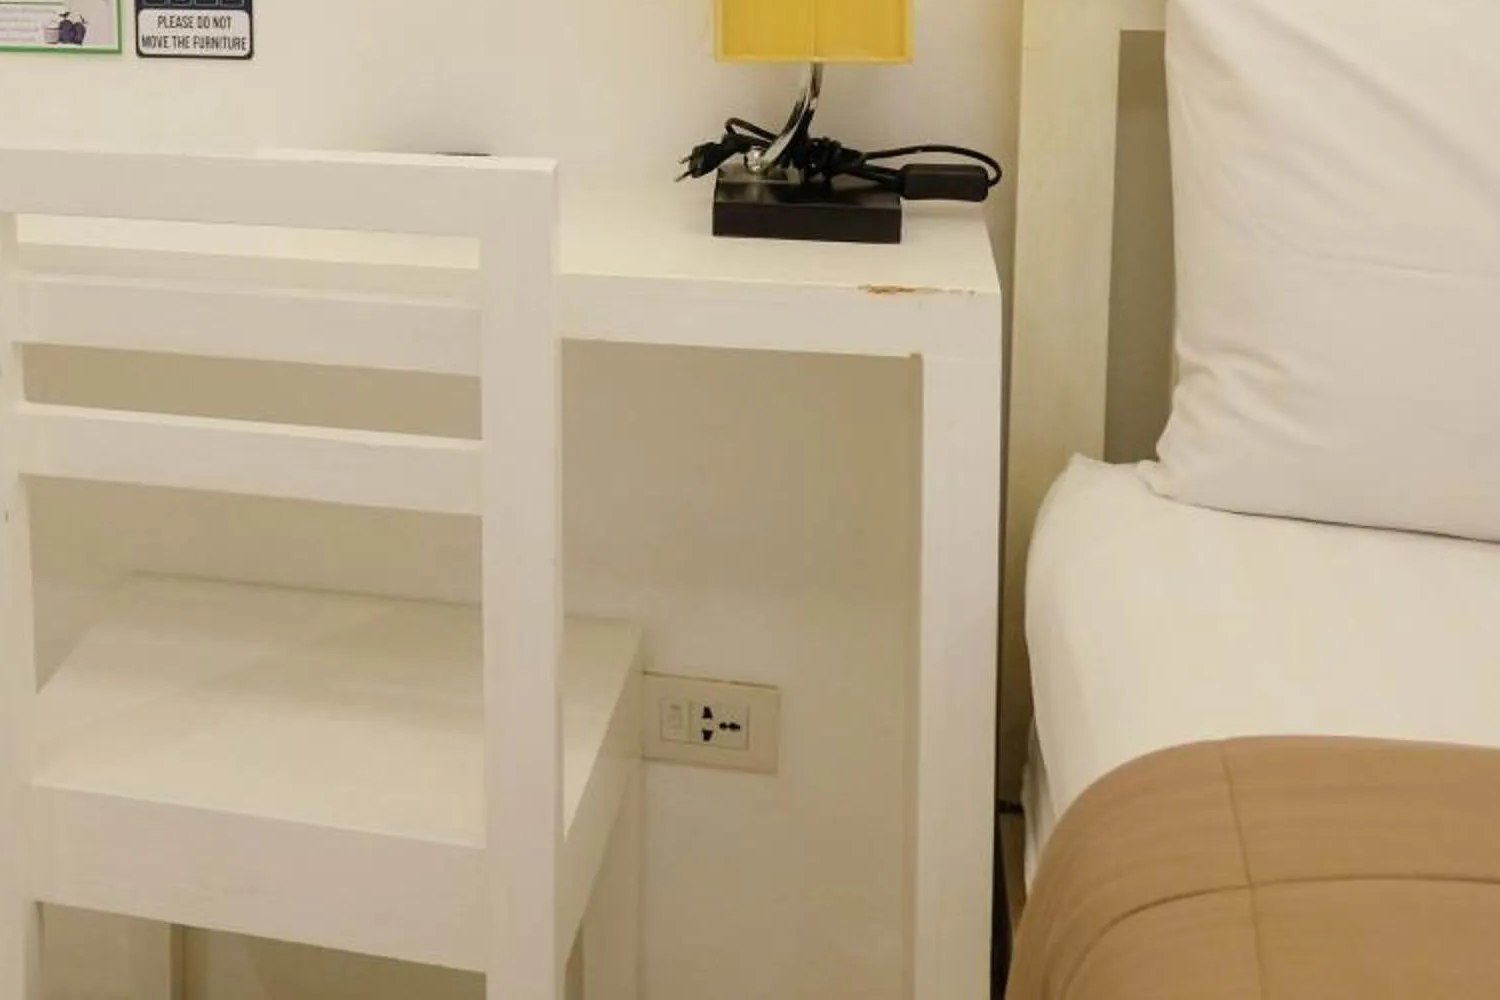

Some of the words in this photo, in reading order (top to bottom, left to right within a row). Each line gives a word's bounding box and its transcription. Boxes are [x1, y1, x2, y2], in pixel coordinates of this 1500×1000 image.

[157, 15, 194, 29] PLEASE
[197, 16, 211, 29] DO
[212, 16, 232, 30] NOT
[142, 34, 170, 50] MOVE
[172, 35, 191, 49] THE
[193, 35, 247, 51] FURNITURE
